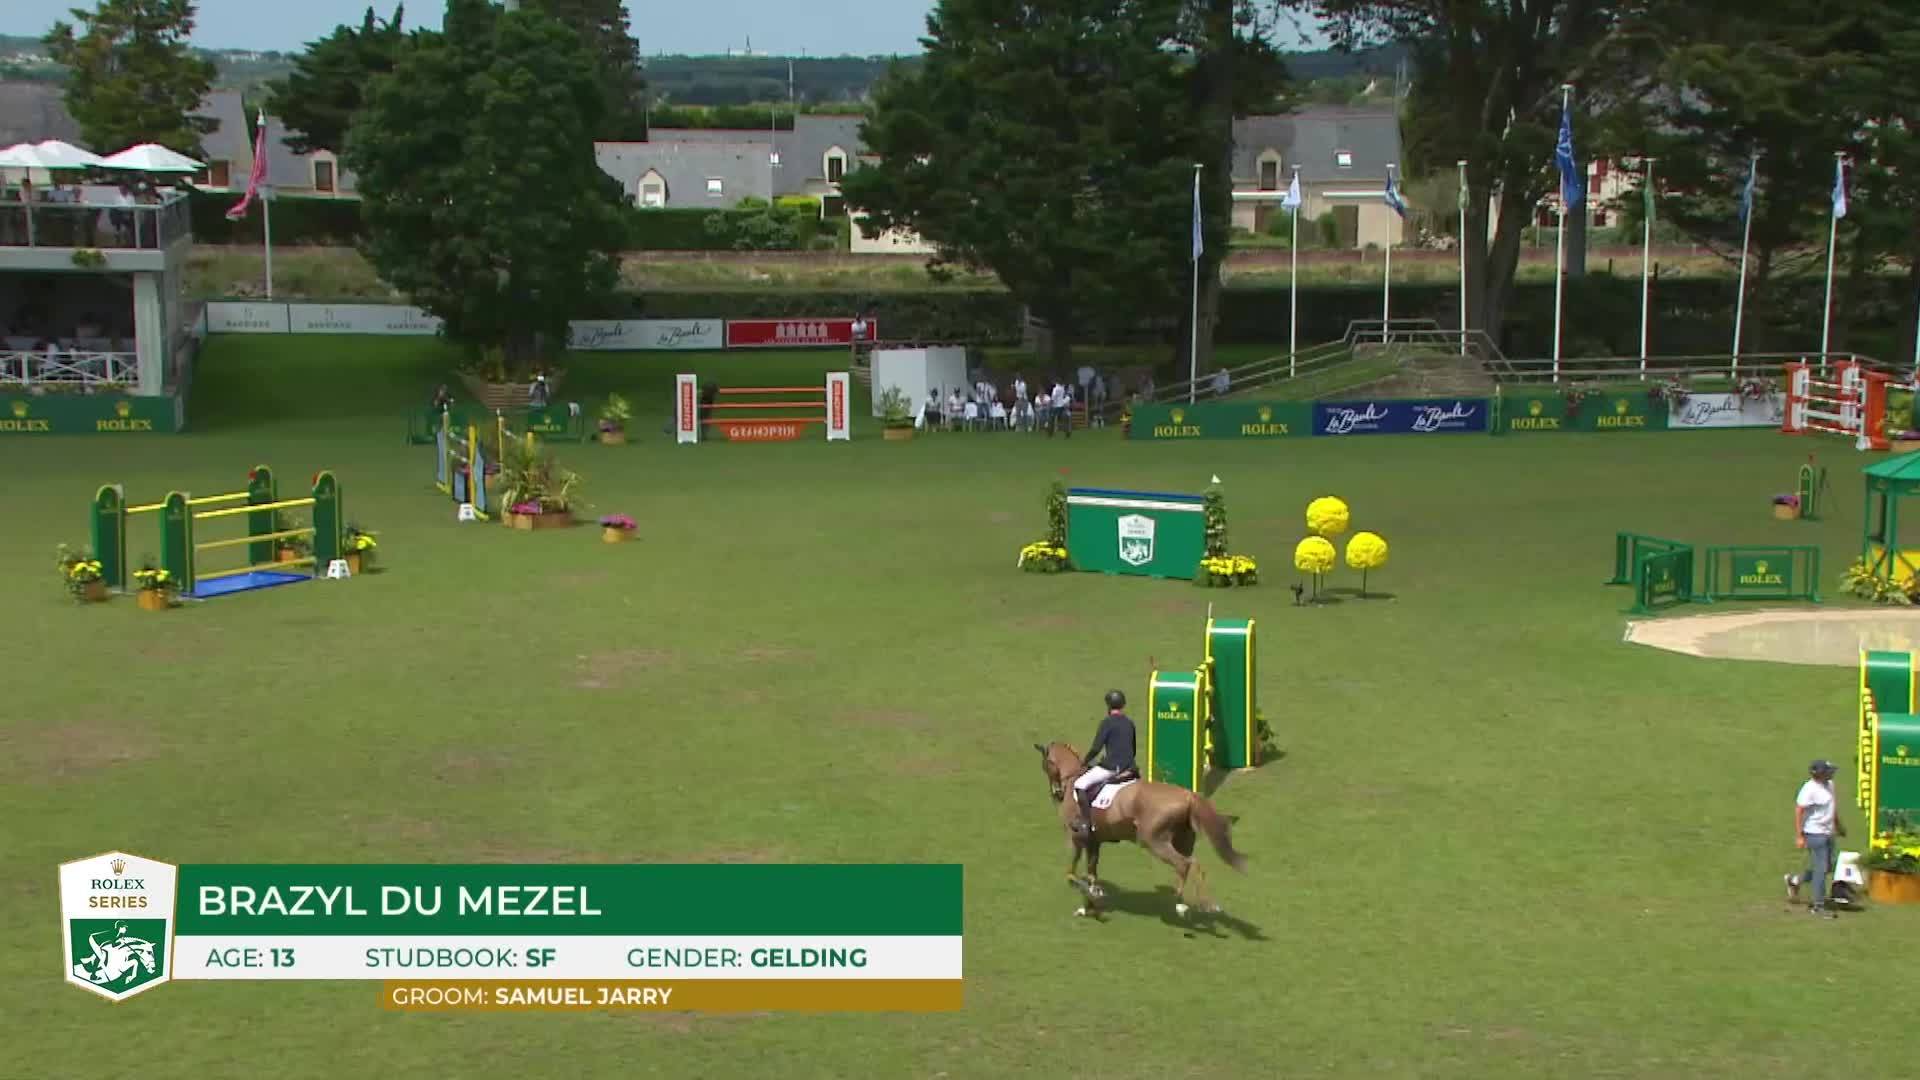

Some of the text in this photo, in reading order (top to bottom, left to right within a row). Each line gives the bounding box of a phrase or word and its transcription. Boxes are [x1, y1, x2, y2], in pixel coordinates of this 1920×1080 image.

[0, 419, 49, 432] OLEX
[96, 419, 152, 431] ROLEX
[1511, 417, 1560, 429] ROLEX
[1597, 415, 1645, 427] ROLEX
[1154, 425, 1200, 437] ROLEX
[1242, 423, 1288, 435] ROLEX
[1740, 574, 1783, 585] ROLEX
[1157, 711, 1189, 721] ROLEX
